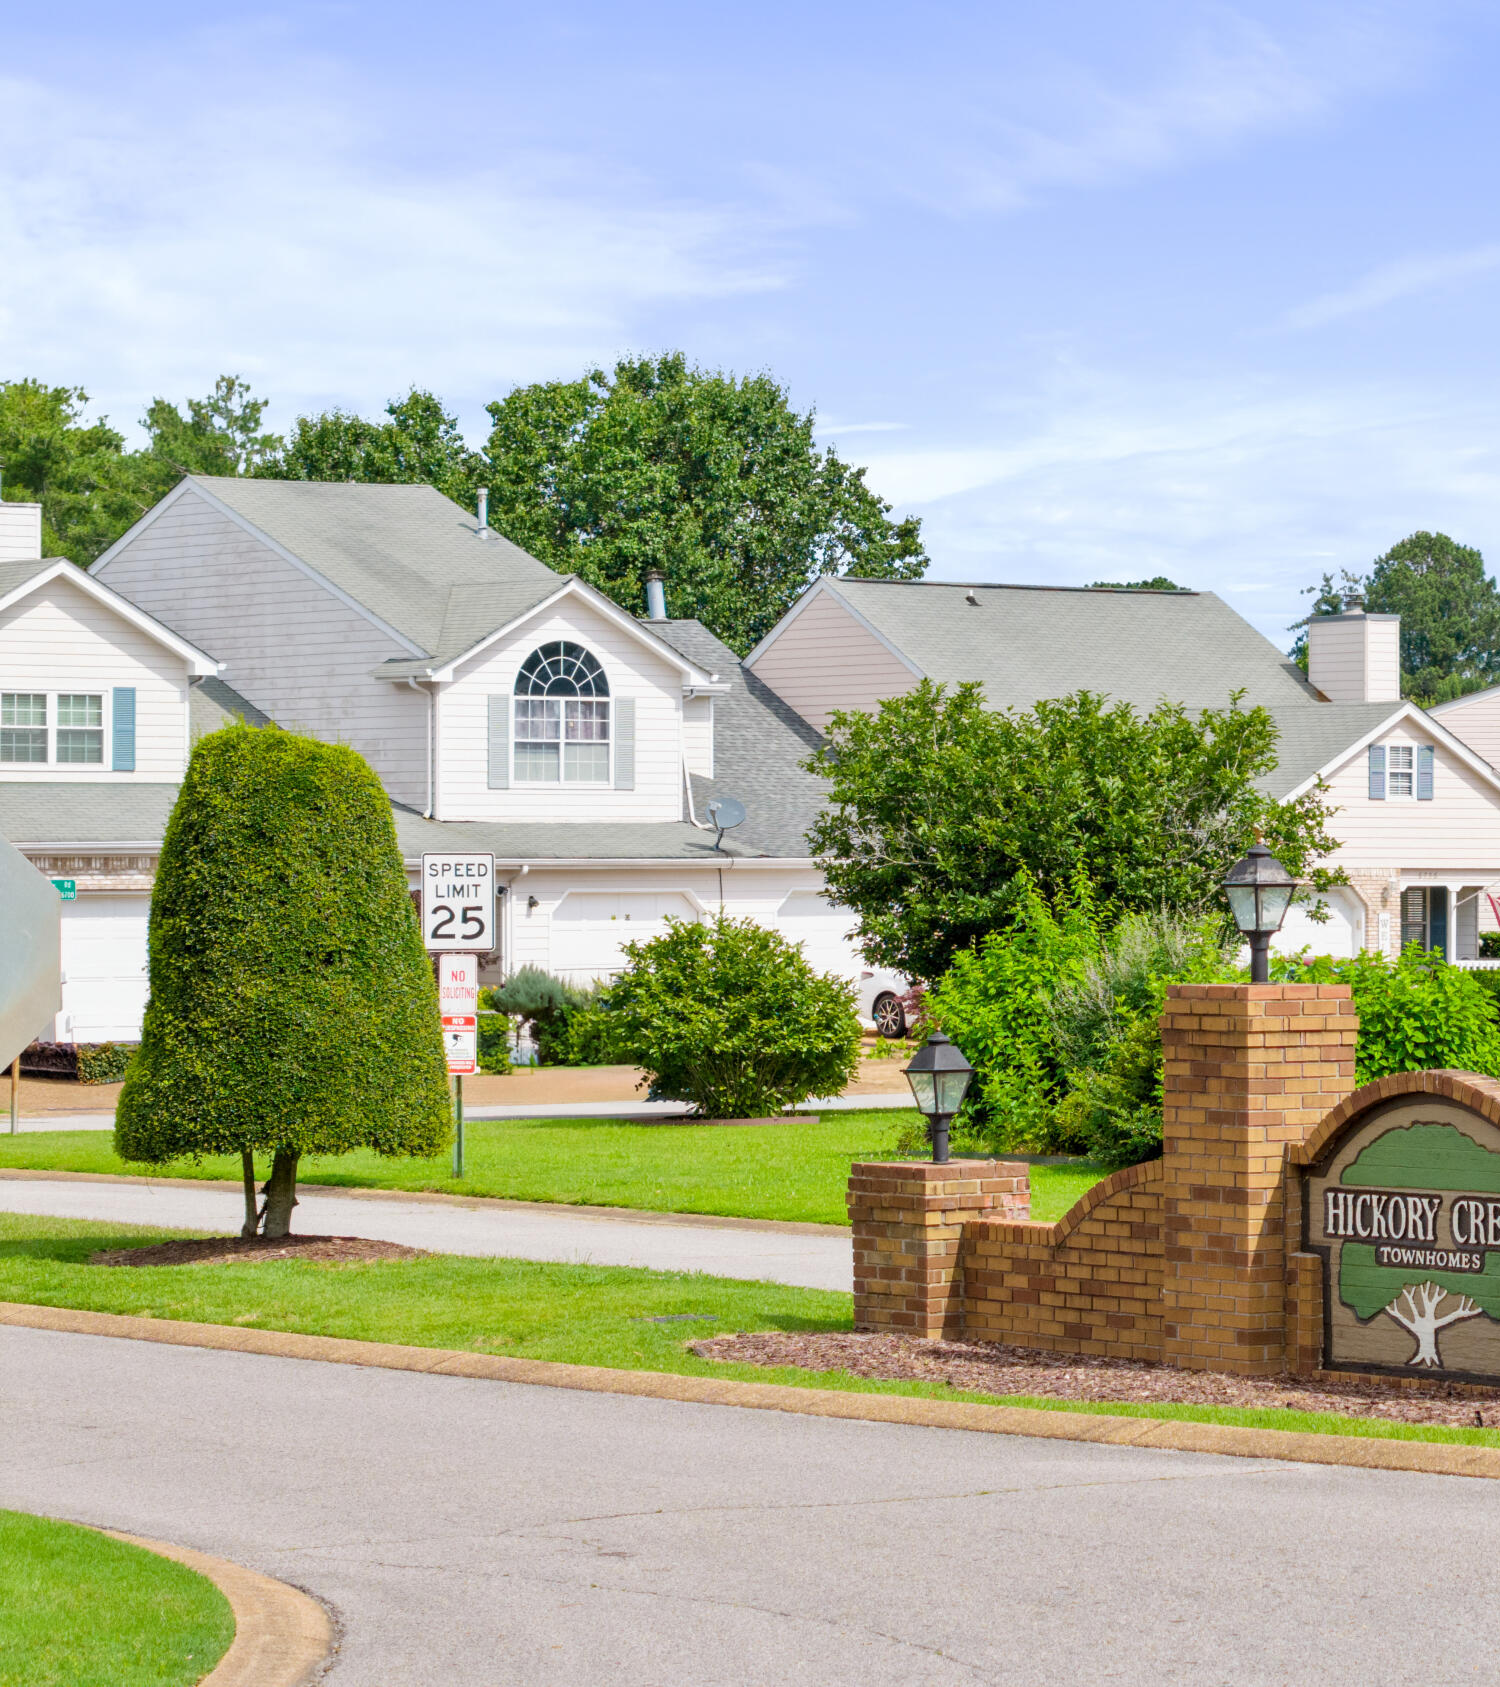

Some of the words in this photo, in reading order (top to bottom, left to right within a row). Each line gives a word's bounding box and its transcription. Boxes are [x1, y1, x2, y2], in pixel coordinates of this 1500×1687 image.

[428, 863, 489, 878] SPEED
[435, 884, 482, 899] LIMIT
[430, 904, 486, 940] 25
[451, 970, 466, 982] NO
[442, 986, 475, 999] SOLICITING
[452, 1017, 465, 1025] NO
[1327, 1192, 1440, 1241] HICKORY
[1380, 1247, 1481, 1269] TOWNHOMES
